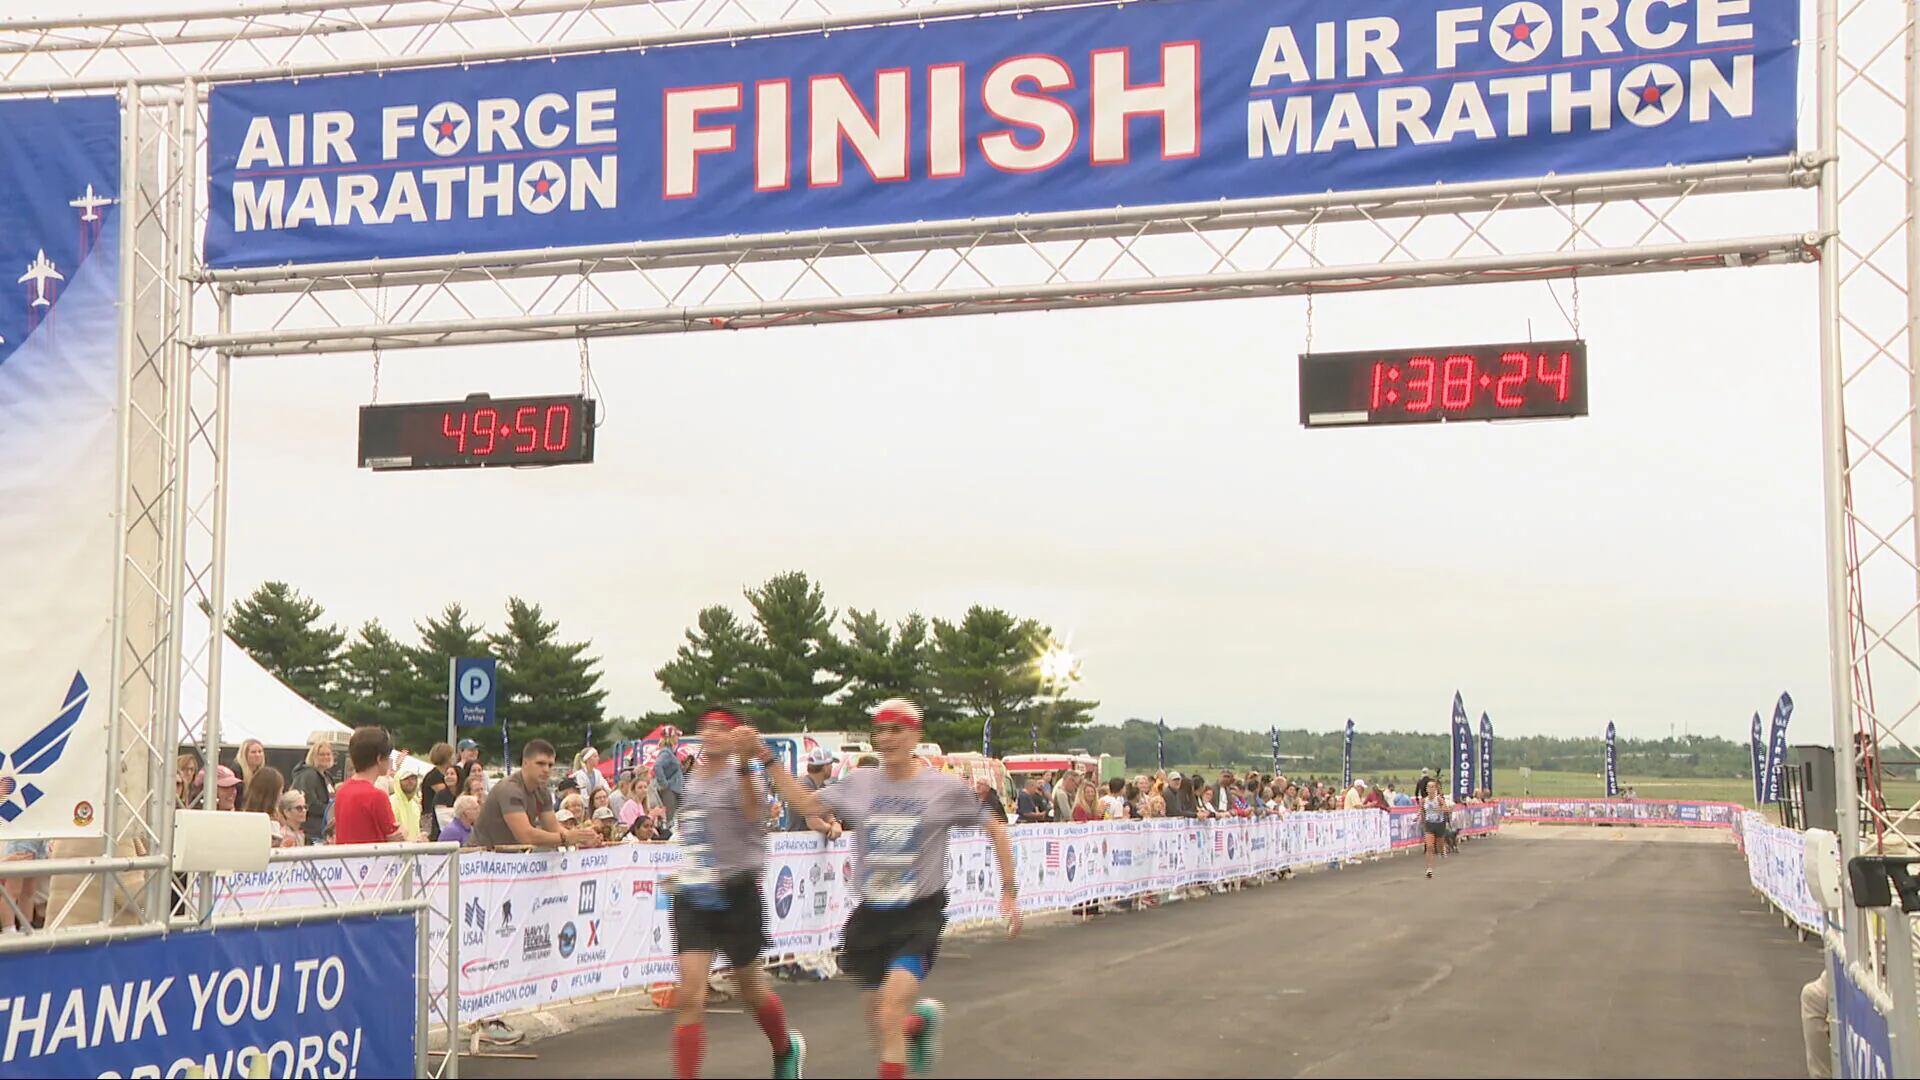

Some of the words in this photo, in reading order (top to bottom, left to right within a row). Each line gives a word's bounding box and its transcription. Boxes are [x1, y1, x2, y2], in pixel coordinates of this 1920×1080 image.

[1250, 16, 1404, 89] AIR
[1435, 0, 1755, 70] FORCE
[235, 111, 357, 171] AIR
[381, 88, 618, 161] FORCE
[662, 40, 1201, 201] FINISH
[1247, 54, 1755, 160] MARATHON
[232, 154, 618, 233] MARATHON
[1460, 753, 1470, 794] FORCE
[460, 861, 547, 876] USAFMARATHON.COM
[463, 931, 484, 946] USAA
[187, 963, 281, 1031] YOU
[294, 955, 345, 1014] TO
